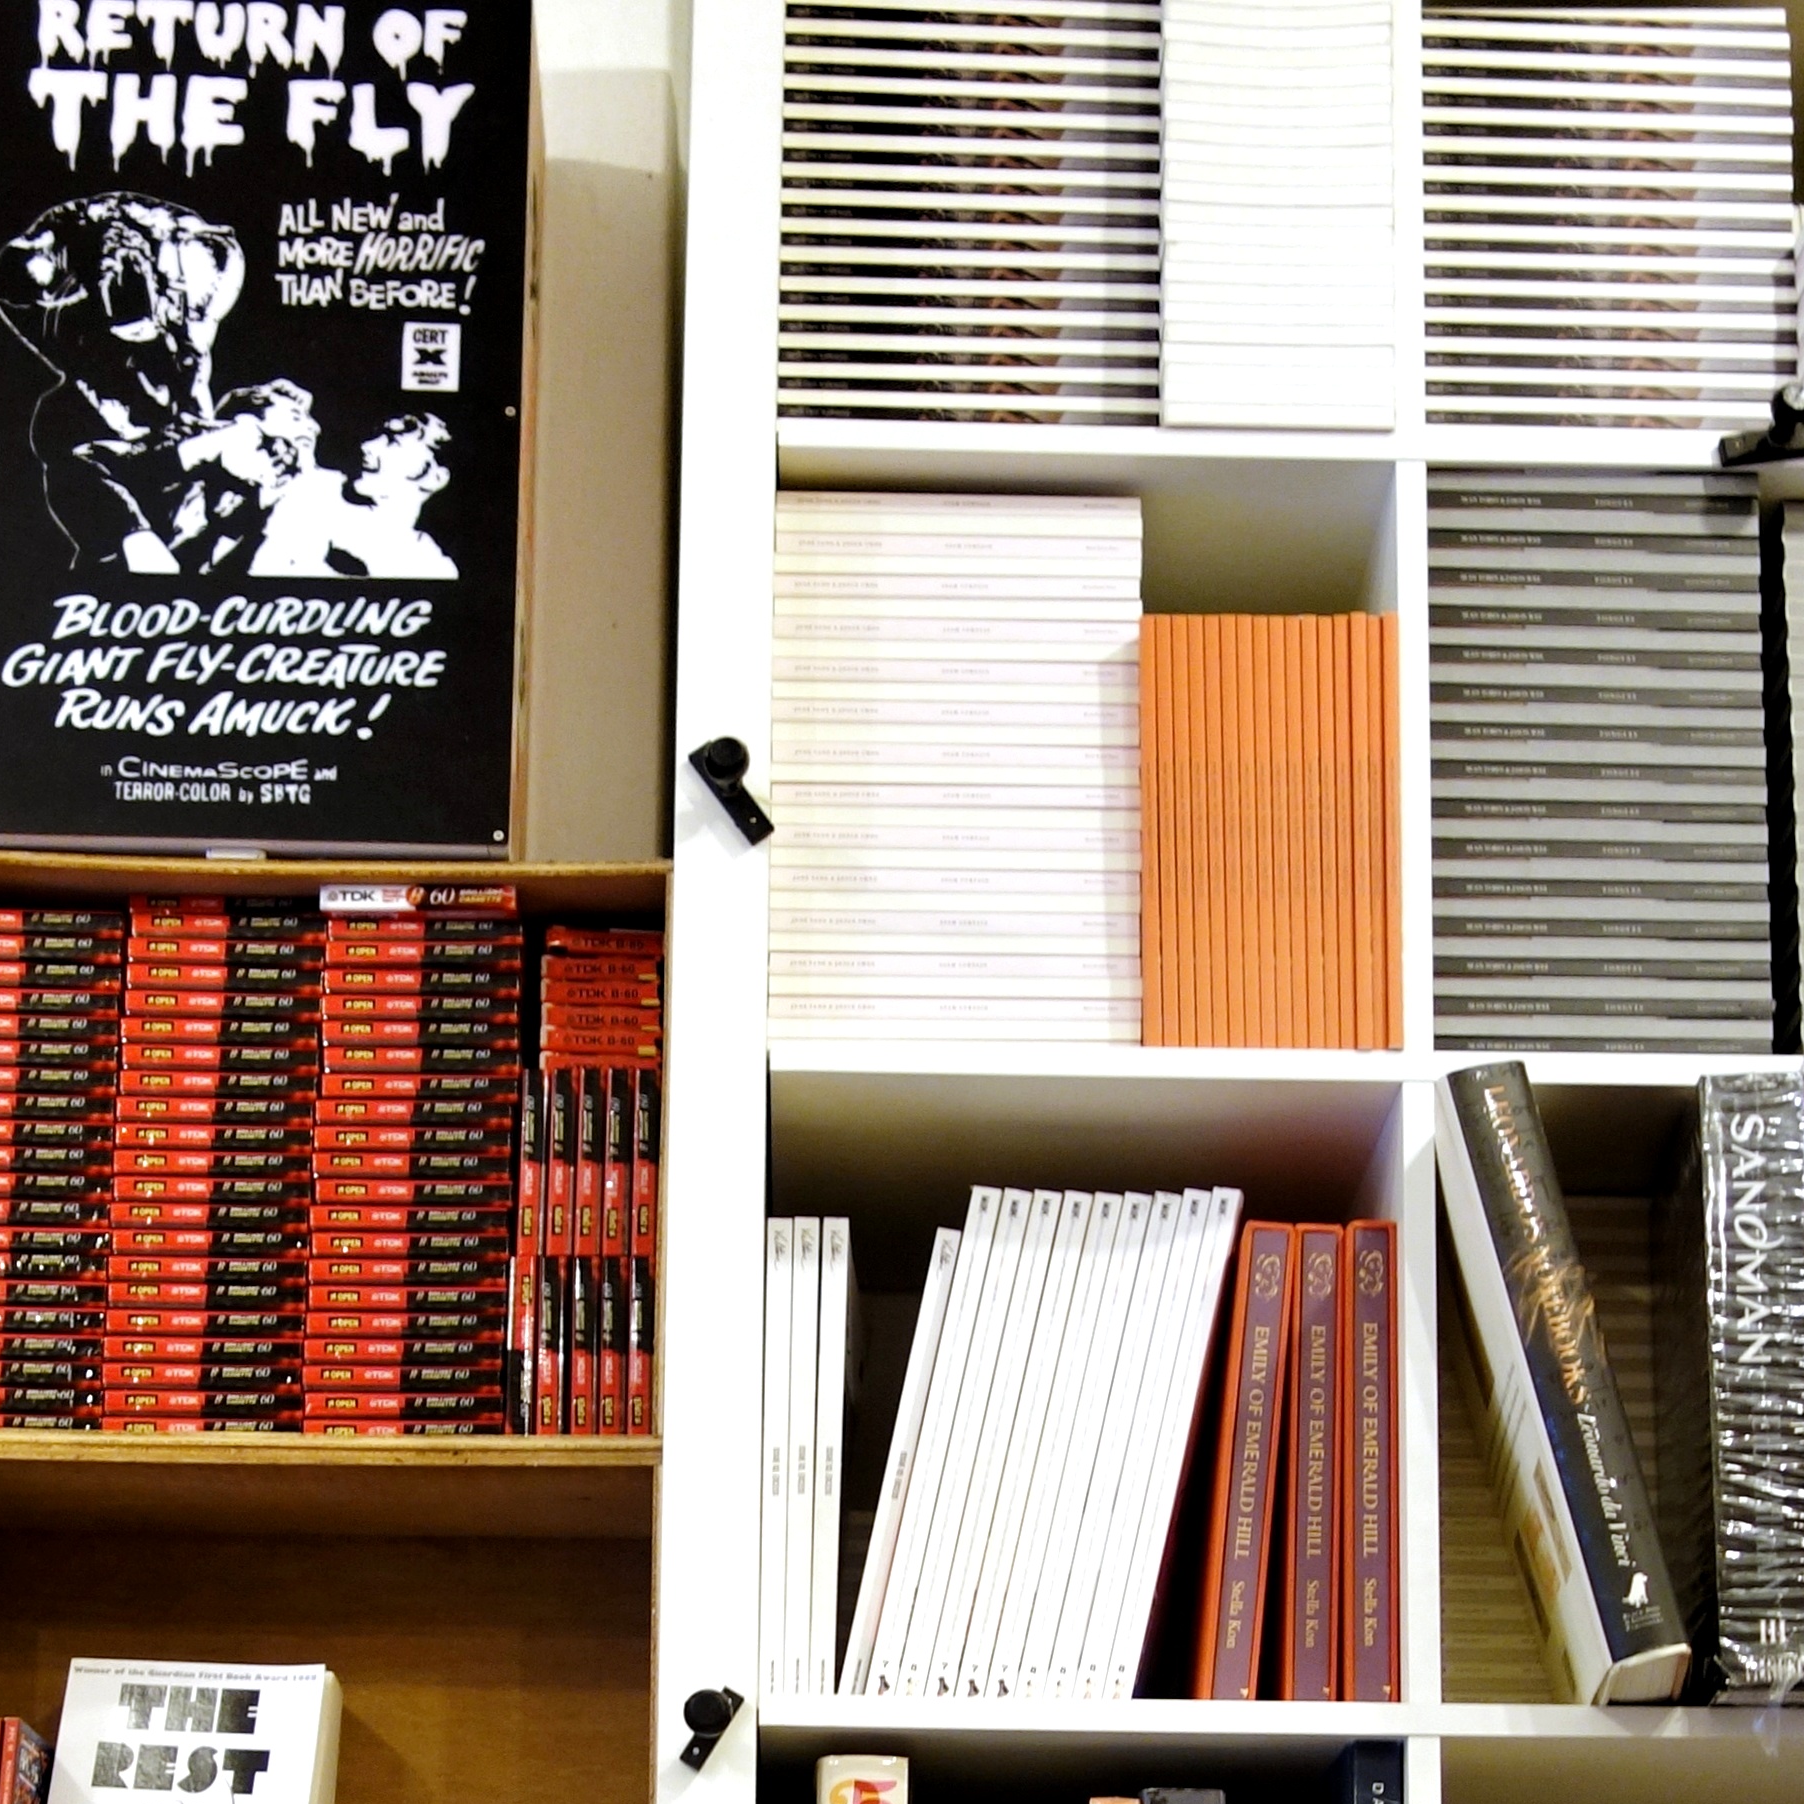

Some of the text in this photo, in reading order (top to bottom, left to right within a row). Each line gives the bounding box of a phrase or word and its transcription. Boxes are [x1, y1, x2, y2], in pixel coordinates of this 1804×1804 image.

[38, 0, 467, 80] RETURN OF
[28, 69, 475, 178] THE FLY
[278, 193, 444, 236] ALL NEW and
[278, 234, 485, 276] MORE HORRIFIC
[275, 268, 343, 306] THAN
[412, 329, 447, 345] CERT
[52, 595, 433, 639] BLOOD-CURDLING
[1, 643, 446, 688] GIANT FLY-CREATURE
[54, 689, 184, 736] RUNS
[238, 787, 253, 805] by
[339, 889, 454, 903] TDK 60
[1234, 1326, 1271, 1560] EMILY OF EMERALD HILL
[118, 1684, 259, 1734] THE
[92, 1742, 270, 1794] REST
